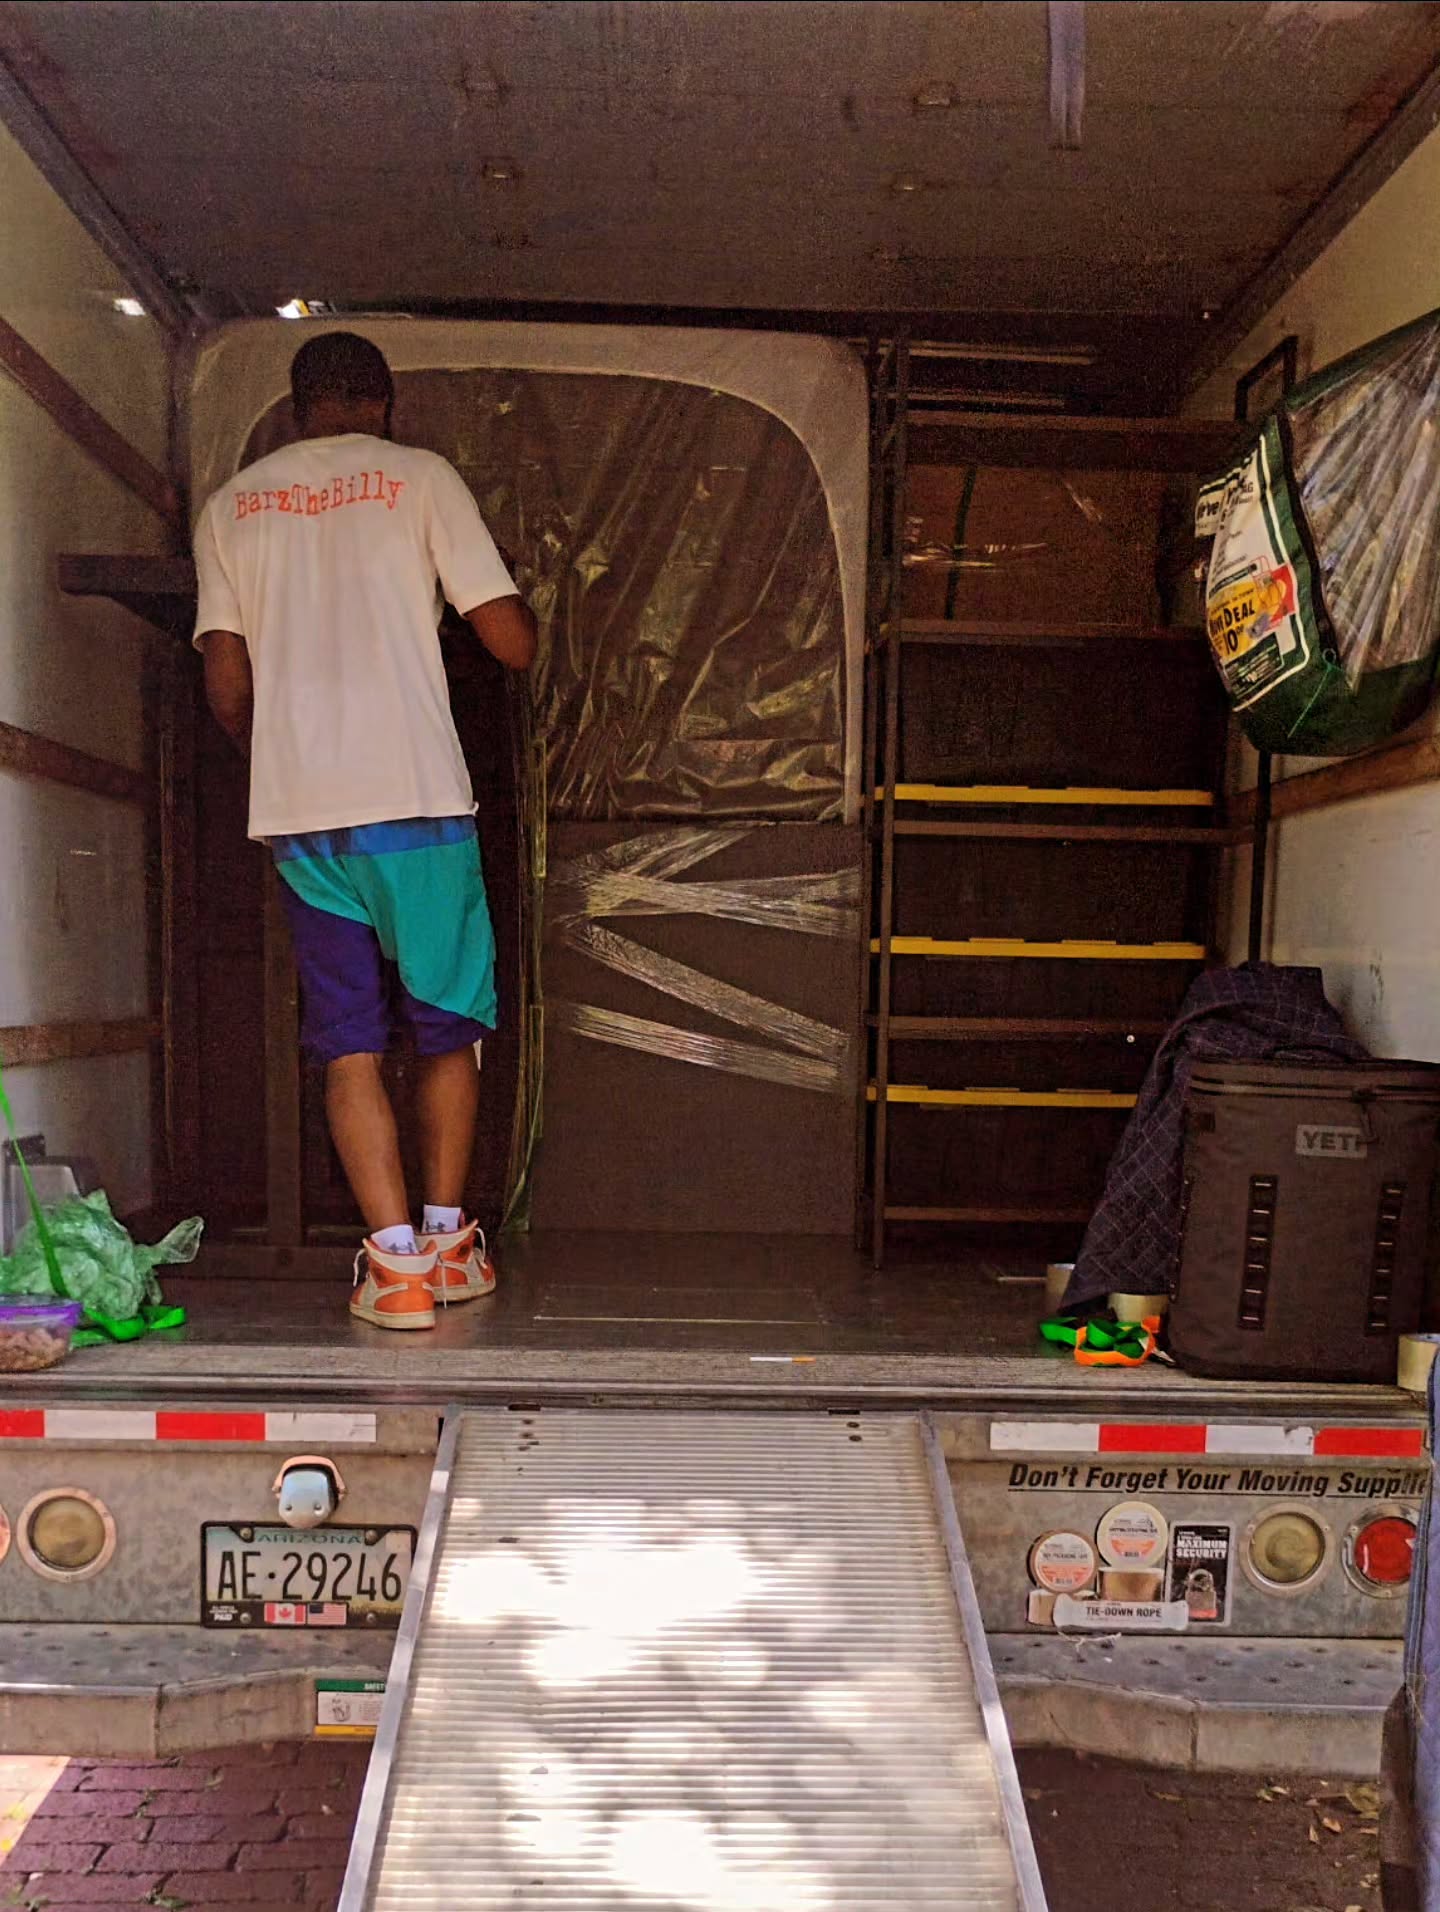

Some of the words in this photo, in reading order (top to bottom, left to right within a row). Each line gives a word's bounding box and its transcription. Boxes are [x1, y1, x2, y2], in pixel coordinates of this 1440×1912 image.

[234, 470, 405, 520] BarzTheBilly
[1223, 600, 1255, 629] DEAL
[1008, 1463, 1077, 1488] Don't
[1085, 1467, 1167, 1495] Forget
[1176, 1468, 1231, 1491] Your
[1237, 1469, 1329, 1497] Moving
[257, 1533, 362, 1545] ARIZONA
[1177, 1540, 1228, 1549] MAXIMUM
[1176, 1548, 1227, 1559] SECURITY
[1086, 1606, 1133, 1617] TIE-DOWN
[1137, 1607, 1162, 1618] ROPE
